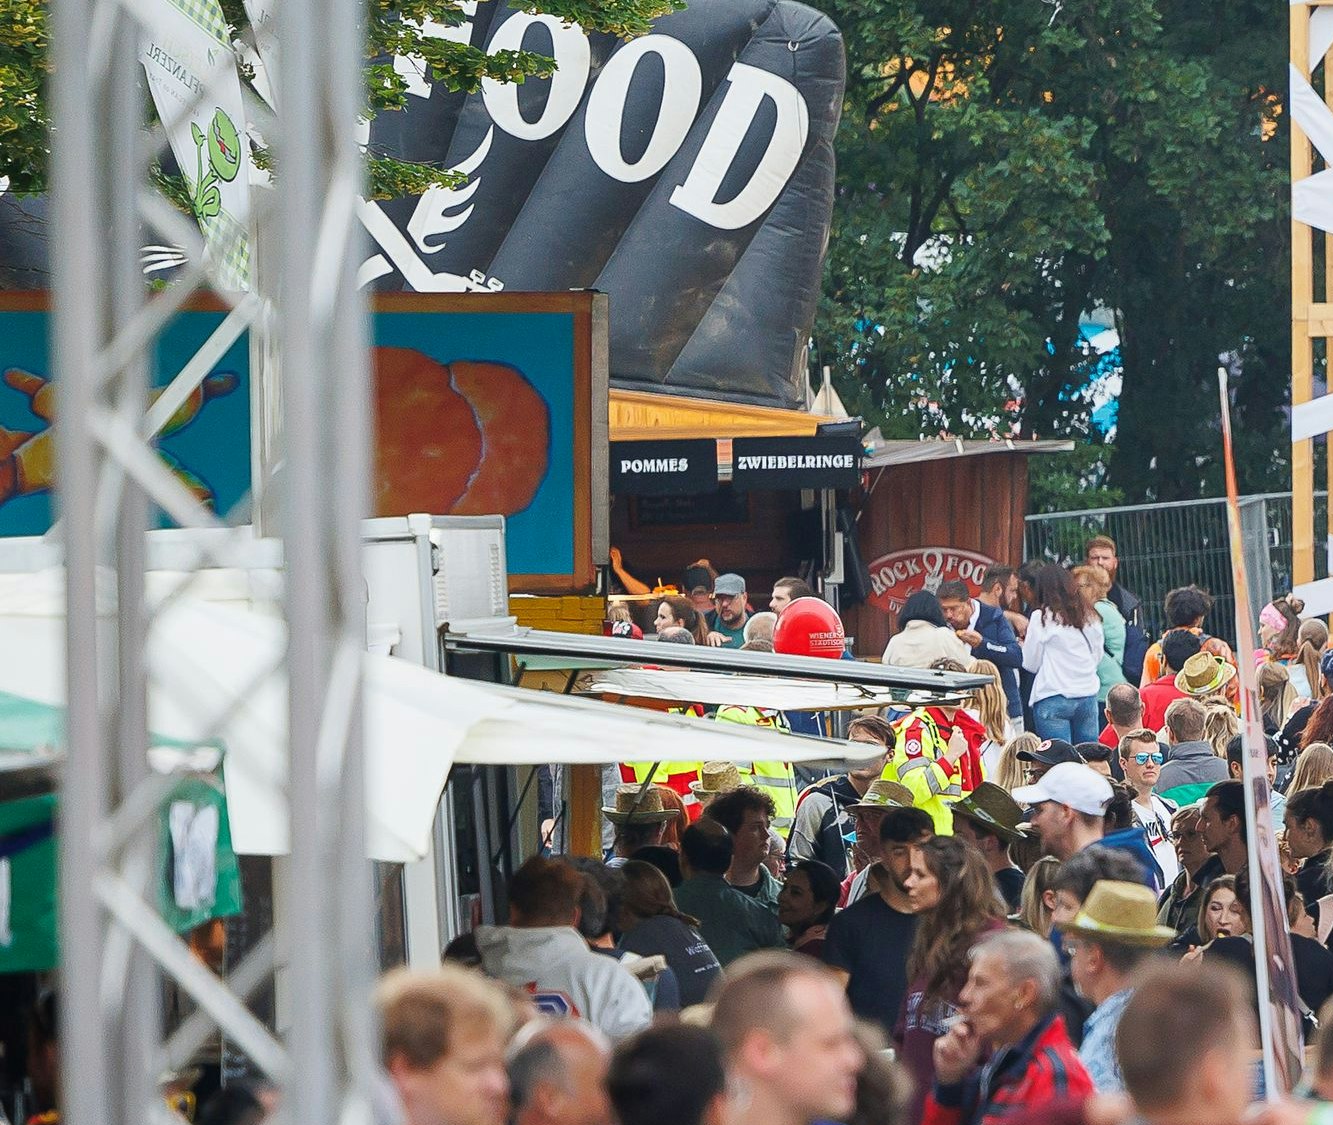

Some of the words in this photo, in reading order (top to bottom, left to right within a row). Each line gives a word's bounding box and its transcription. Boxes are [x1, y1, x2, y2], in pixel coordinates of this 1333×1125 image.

[621, 458, 689, 474] POMMES
[738, 454, 854, 470] ZWIEBELRINGE
[869, 556, 922, 597] ROCK
[945, 555, 988, 586] FOO
